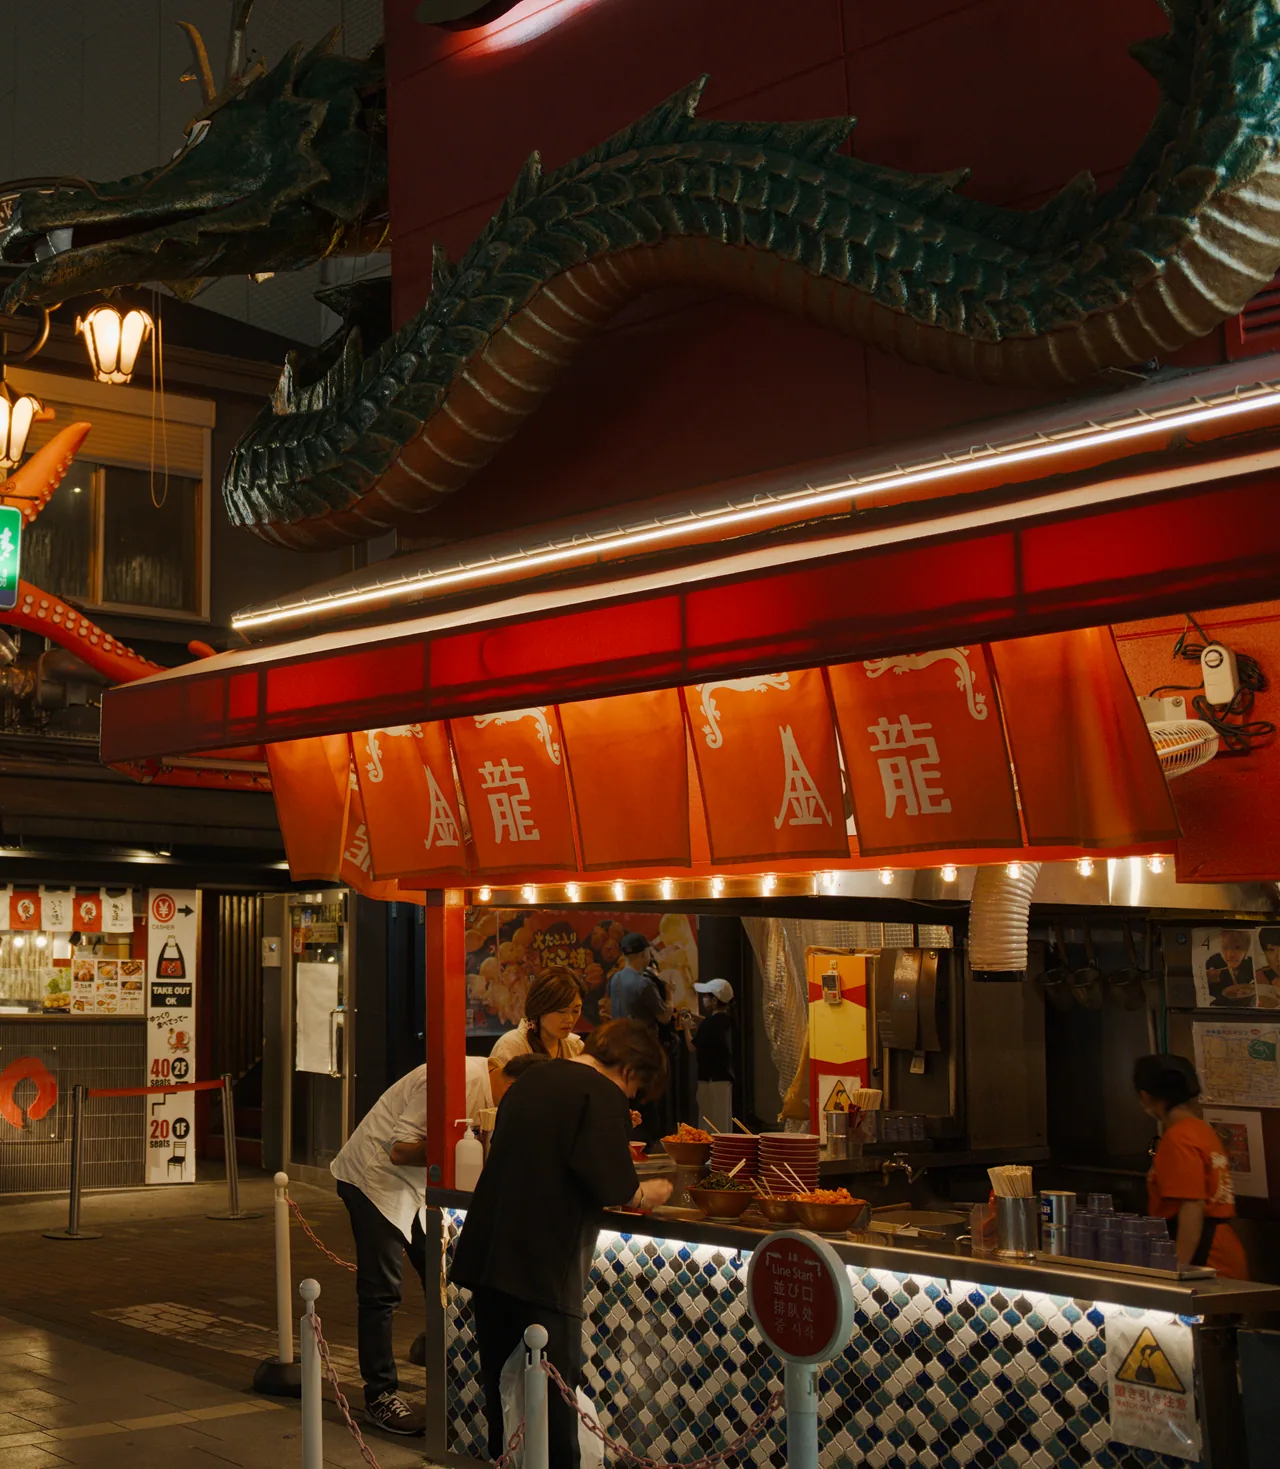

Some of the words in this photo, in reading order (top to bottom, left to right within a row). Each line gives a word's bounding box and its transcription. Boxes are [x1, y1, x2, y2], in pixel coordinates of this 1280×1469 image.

[774, 724, 833, 830] 金
[867, 714, 951, 819] 龍
[477, 757, 540, 843] 龍
[152, 986, 173, 995] TAKE
[174, 986, 190, 995] OUT
[165, 997, 177, 1005] OK
[150, 1011, 170, 1023] ゆっくり
[150, 1058, 170, 1078] 40
[173, 1062, 187, 1075] 2F
[150, 1079, 171, 1087] seats
[150, 1119, 170, 1139] 20
[174, 1122, 187, 1136] 1F
[149, 1139, 170, 1148] seats
[772, 1263, 791, 1277] Line
[792, 1267, 813, 1283] Start
[773, 1280, 814, 1303] 並び口
[773, 1299, 814, 1322] 排队处
